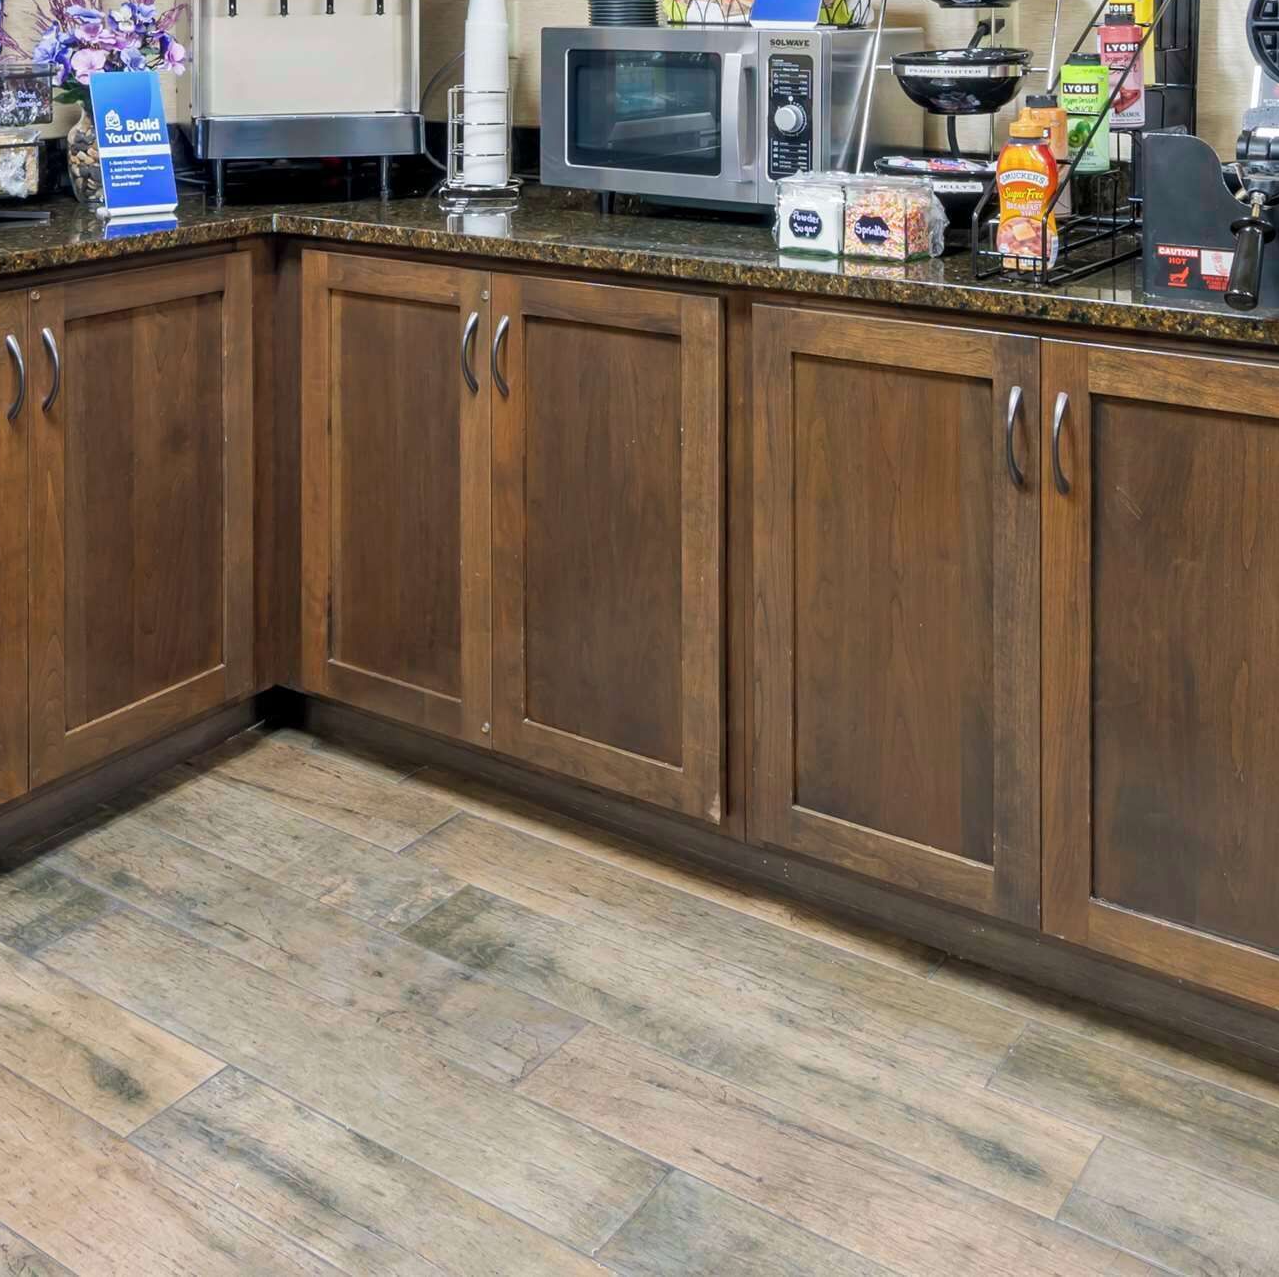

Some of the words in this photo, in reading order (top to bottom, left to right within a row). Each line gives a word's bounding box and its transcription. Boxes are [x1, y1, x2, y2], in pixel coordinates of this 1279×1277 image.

[1109, 4, 1133, 12] YONS
[770, 39, 810, 47] SOLWAVE
[1063, 84, 1097, 93] LYONS
[126, 118, 160, 131] Build
[105, 133, 132, 144] Your
[133, 131, 162, 142] Own
[1003, 187, 1026, 202] Sugar
[1026, 188, 1044, 200] Free
[792, 210, 820, 224] Powder
[793, 223, 817, 236] Sugar
[1158, 246, 1199, 257] CAUTION
[1168, 257, 1188, 265] HOT
